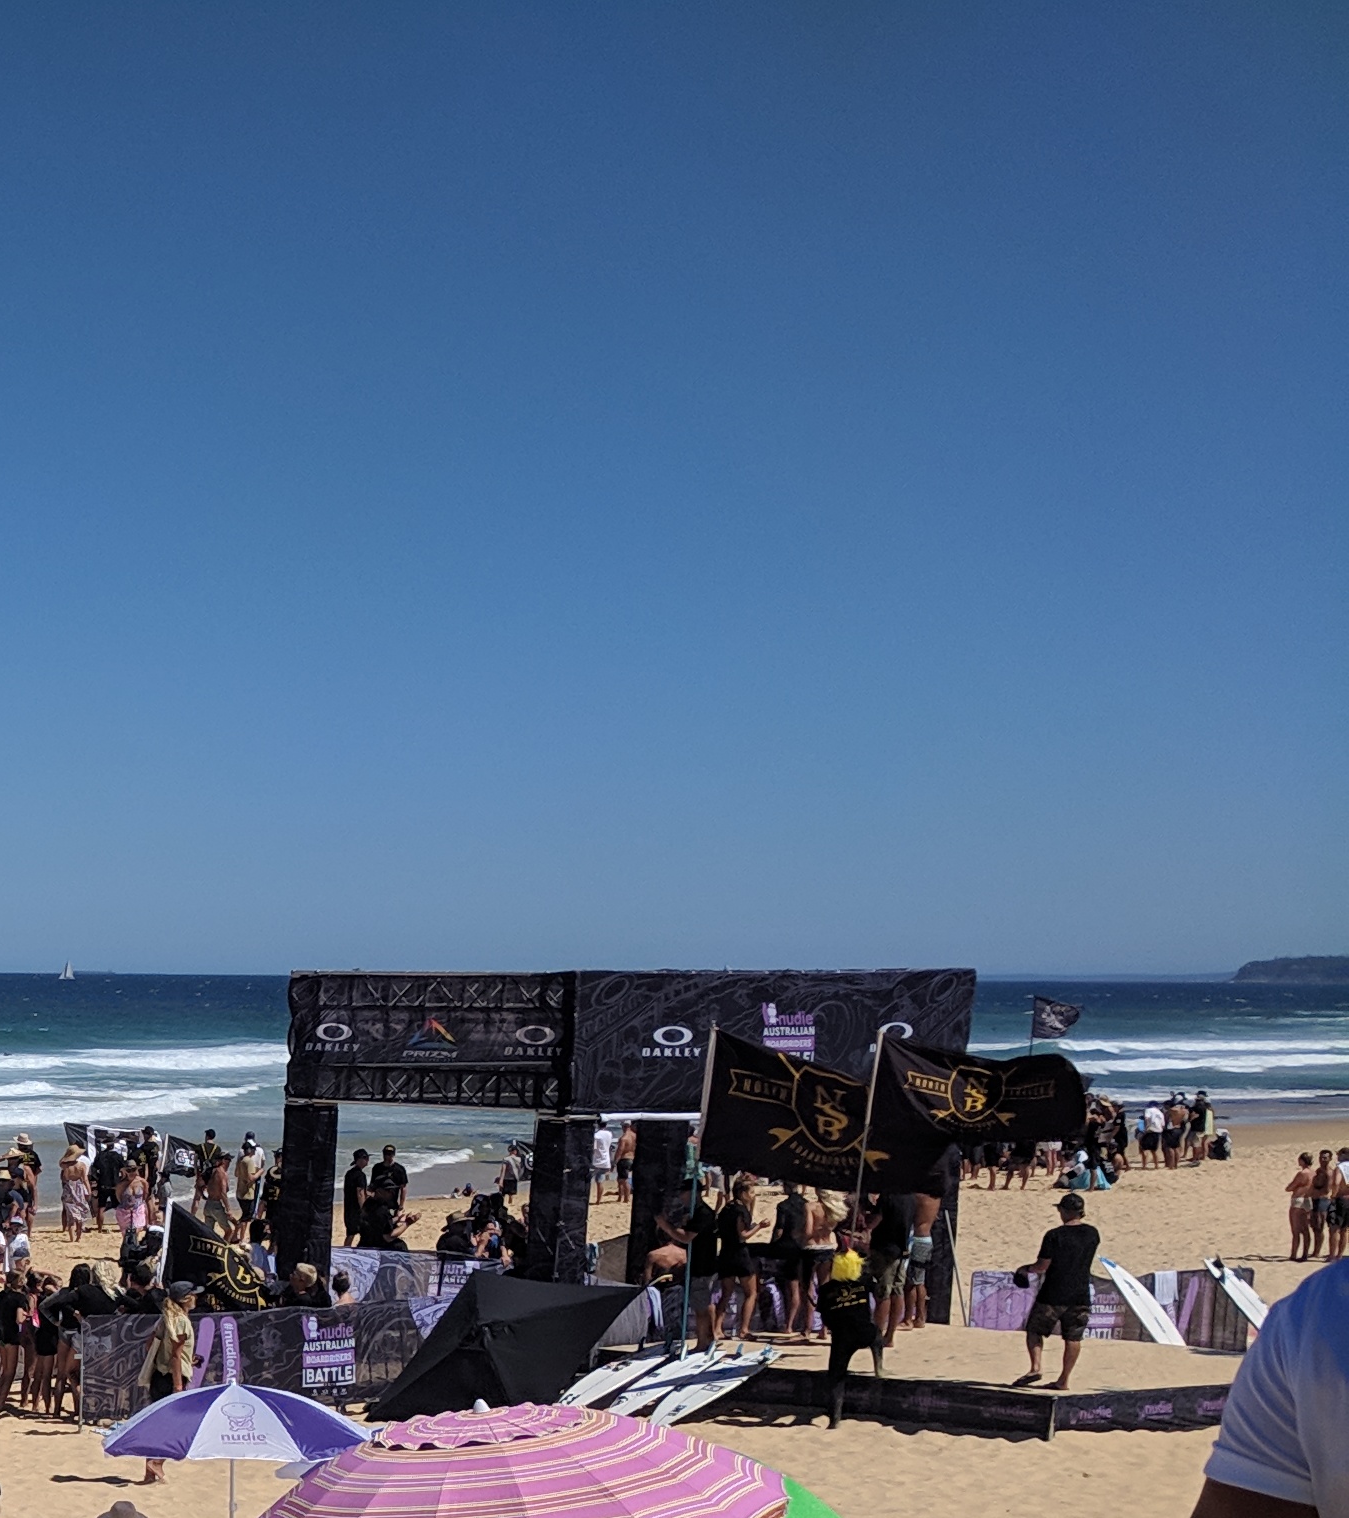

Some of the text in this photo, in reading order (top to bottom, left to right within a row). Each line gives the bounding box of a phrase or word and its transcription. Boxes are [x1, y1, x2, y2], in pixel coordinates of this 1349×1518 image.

[778, 1010, 814, 1026] nudie
[762, 1026, 816, 1037] AUSTRALIAN
[305, 1042, 359, 1051] OAKLEY
[504, 1046, 562, 1056] OAKLEY
[402, 1050, 457, 1059] PRIZM
[641, 1047, 701, 1057] OAKLEY
[319, 1322, 354, 1340] nudie
[302, 1337, 356, 1352] AUSTRALIAN
[306, 1365, 353, 1383] BATTLE
[220, 1432, 267, 1442] nudie
